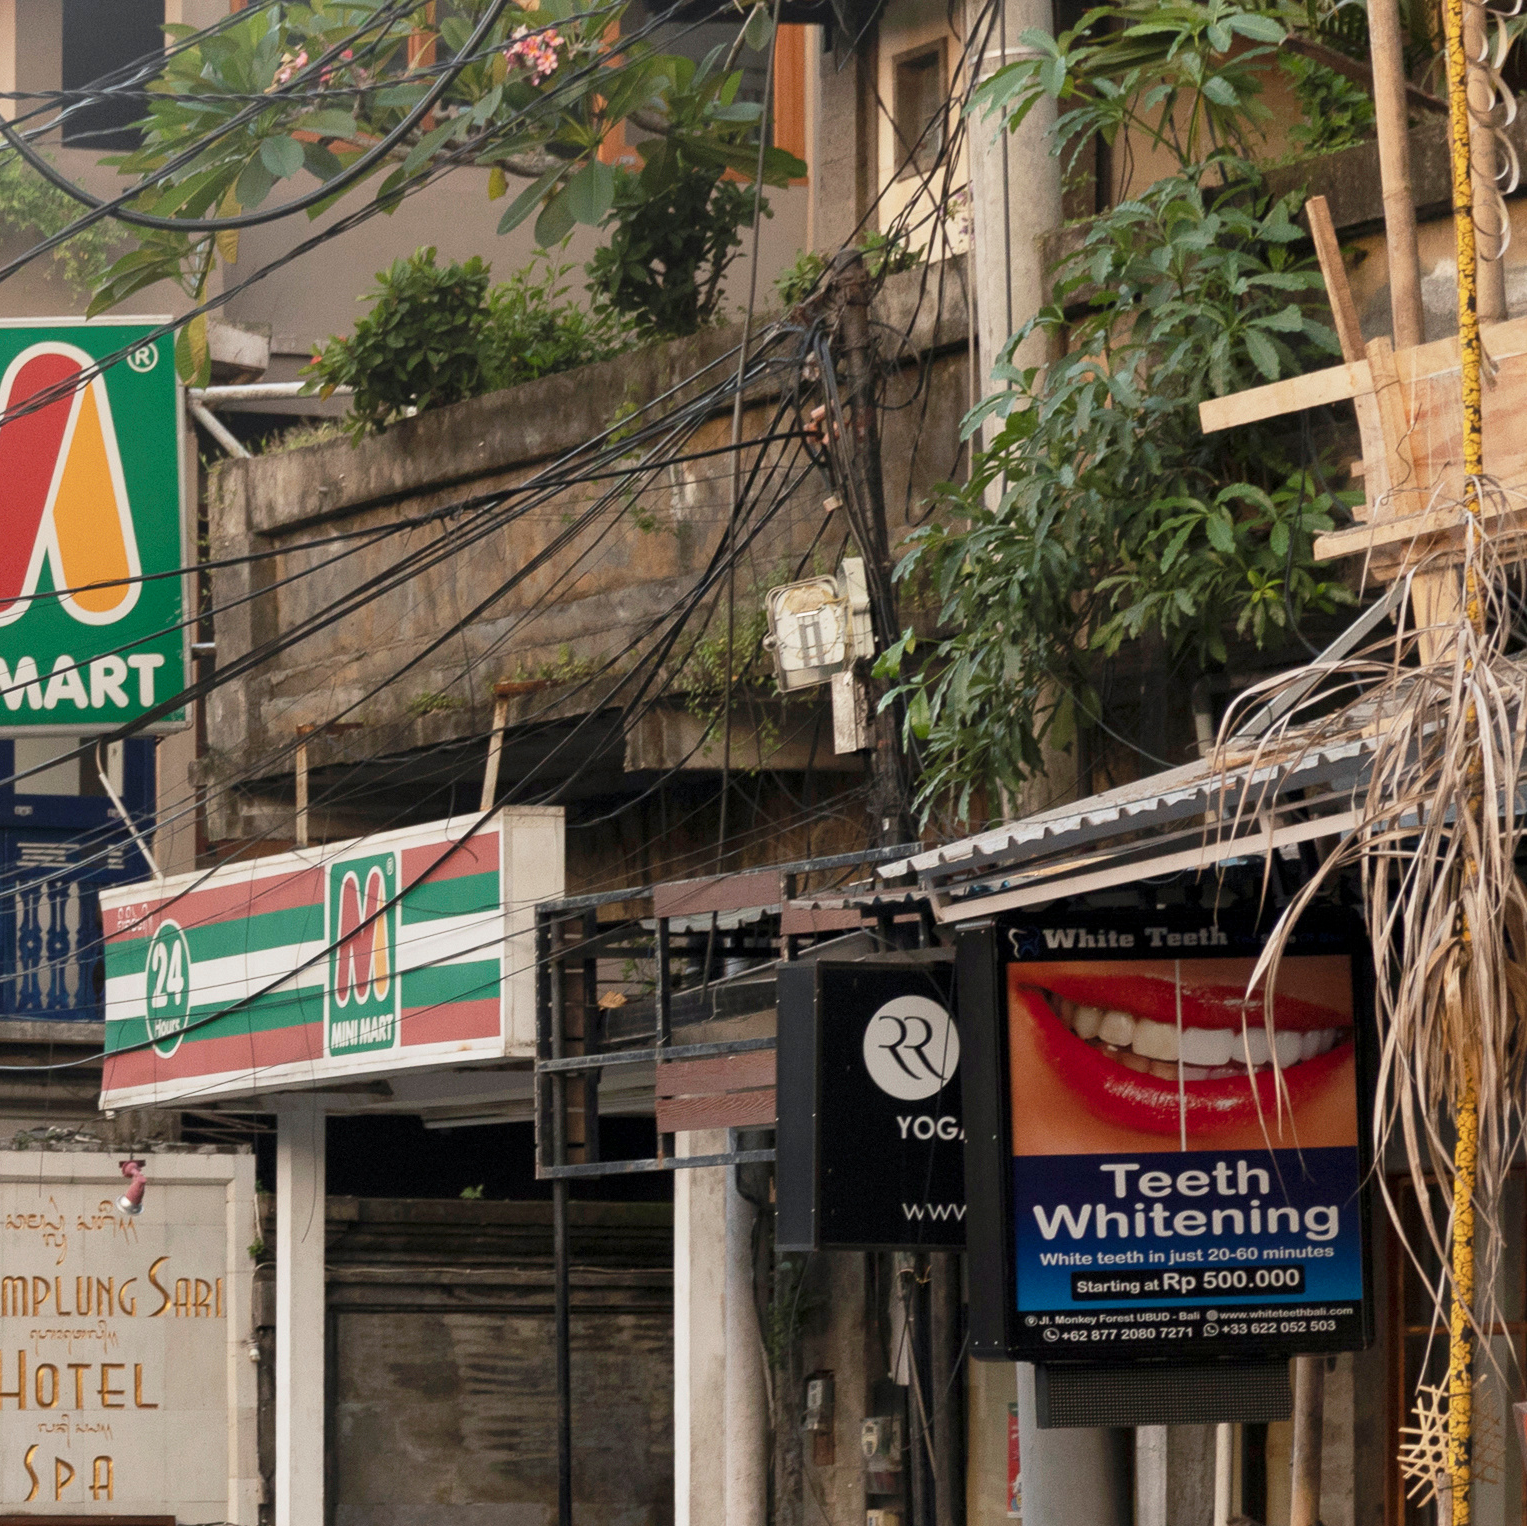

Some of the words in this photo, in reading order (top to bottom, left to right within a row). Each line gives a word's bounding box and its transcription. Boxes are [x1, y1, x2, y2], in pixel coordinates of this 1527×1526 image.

[1043, 929, 1135, 949] White
[1144, 927, 1228, 947] Teeth
[151, 939, 184, 1008] 24
[154, 1018, 181, 1038] Hours
[331, 1020, 358, 1049] MINI
[359, 1014, 394, 1046] MART
[1100, 1160, 1270, 1199] Teeth
[1033, 1200, 1340, 1241] Whitening
[1040, 1251, 1093, 1266] White
[1097, 1250, 1145, 1264] teeth
[1149, 1250, 1165, 1263] in
[1168, 1248, 1204, 1265] just
[1208, 1247, 1258, 1261] 20-60
[1262, 1244, 1335, 1259] minutes
[148, 1256, 224, 1317] SARI
[1077, 1279, 1140, 1294] Starting
[1144, 1280, 1160, 1291] at
[1163, 1273, 1196, 1293] Rp
[1203, 1268, 1300, 1289] 500.000
[1055, 1315, 1096, 1328] Monkey
[1099, 1313, 1135, 1324] Forest
[1137, 1312, 1169, 1322] UBUD
[1179, 1311, 1200, 1321] Bali
[1219, 1306, 1353, 1320] www.whiteteethbali.com
[1061, 1331, 1088, 1342] +62
[1091, 1329, 1118, 1341] 877
[1120, 1328, 1156, 1340] 2080
[1159, 1327, 1193, 1339] 7271
[1221, 1325, 1248, 1336] +33
[1251, 1323, 1277, 1335] 622
[1281, 1322, 1307, 1334] 052
[1310, 1320, 1336, 1333] 503
[23, 1444, 114, 1502] SPA
